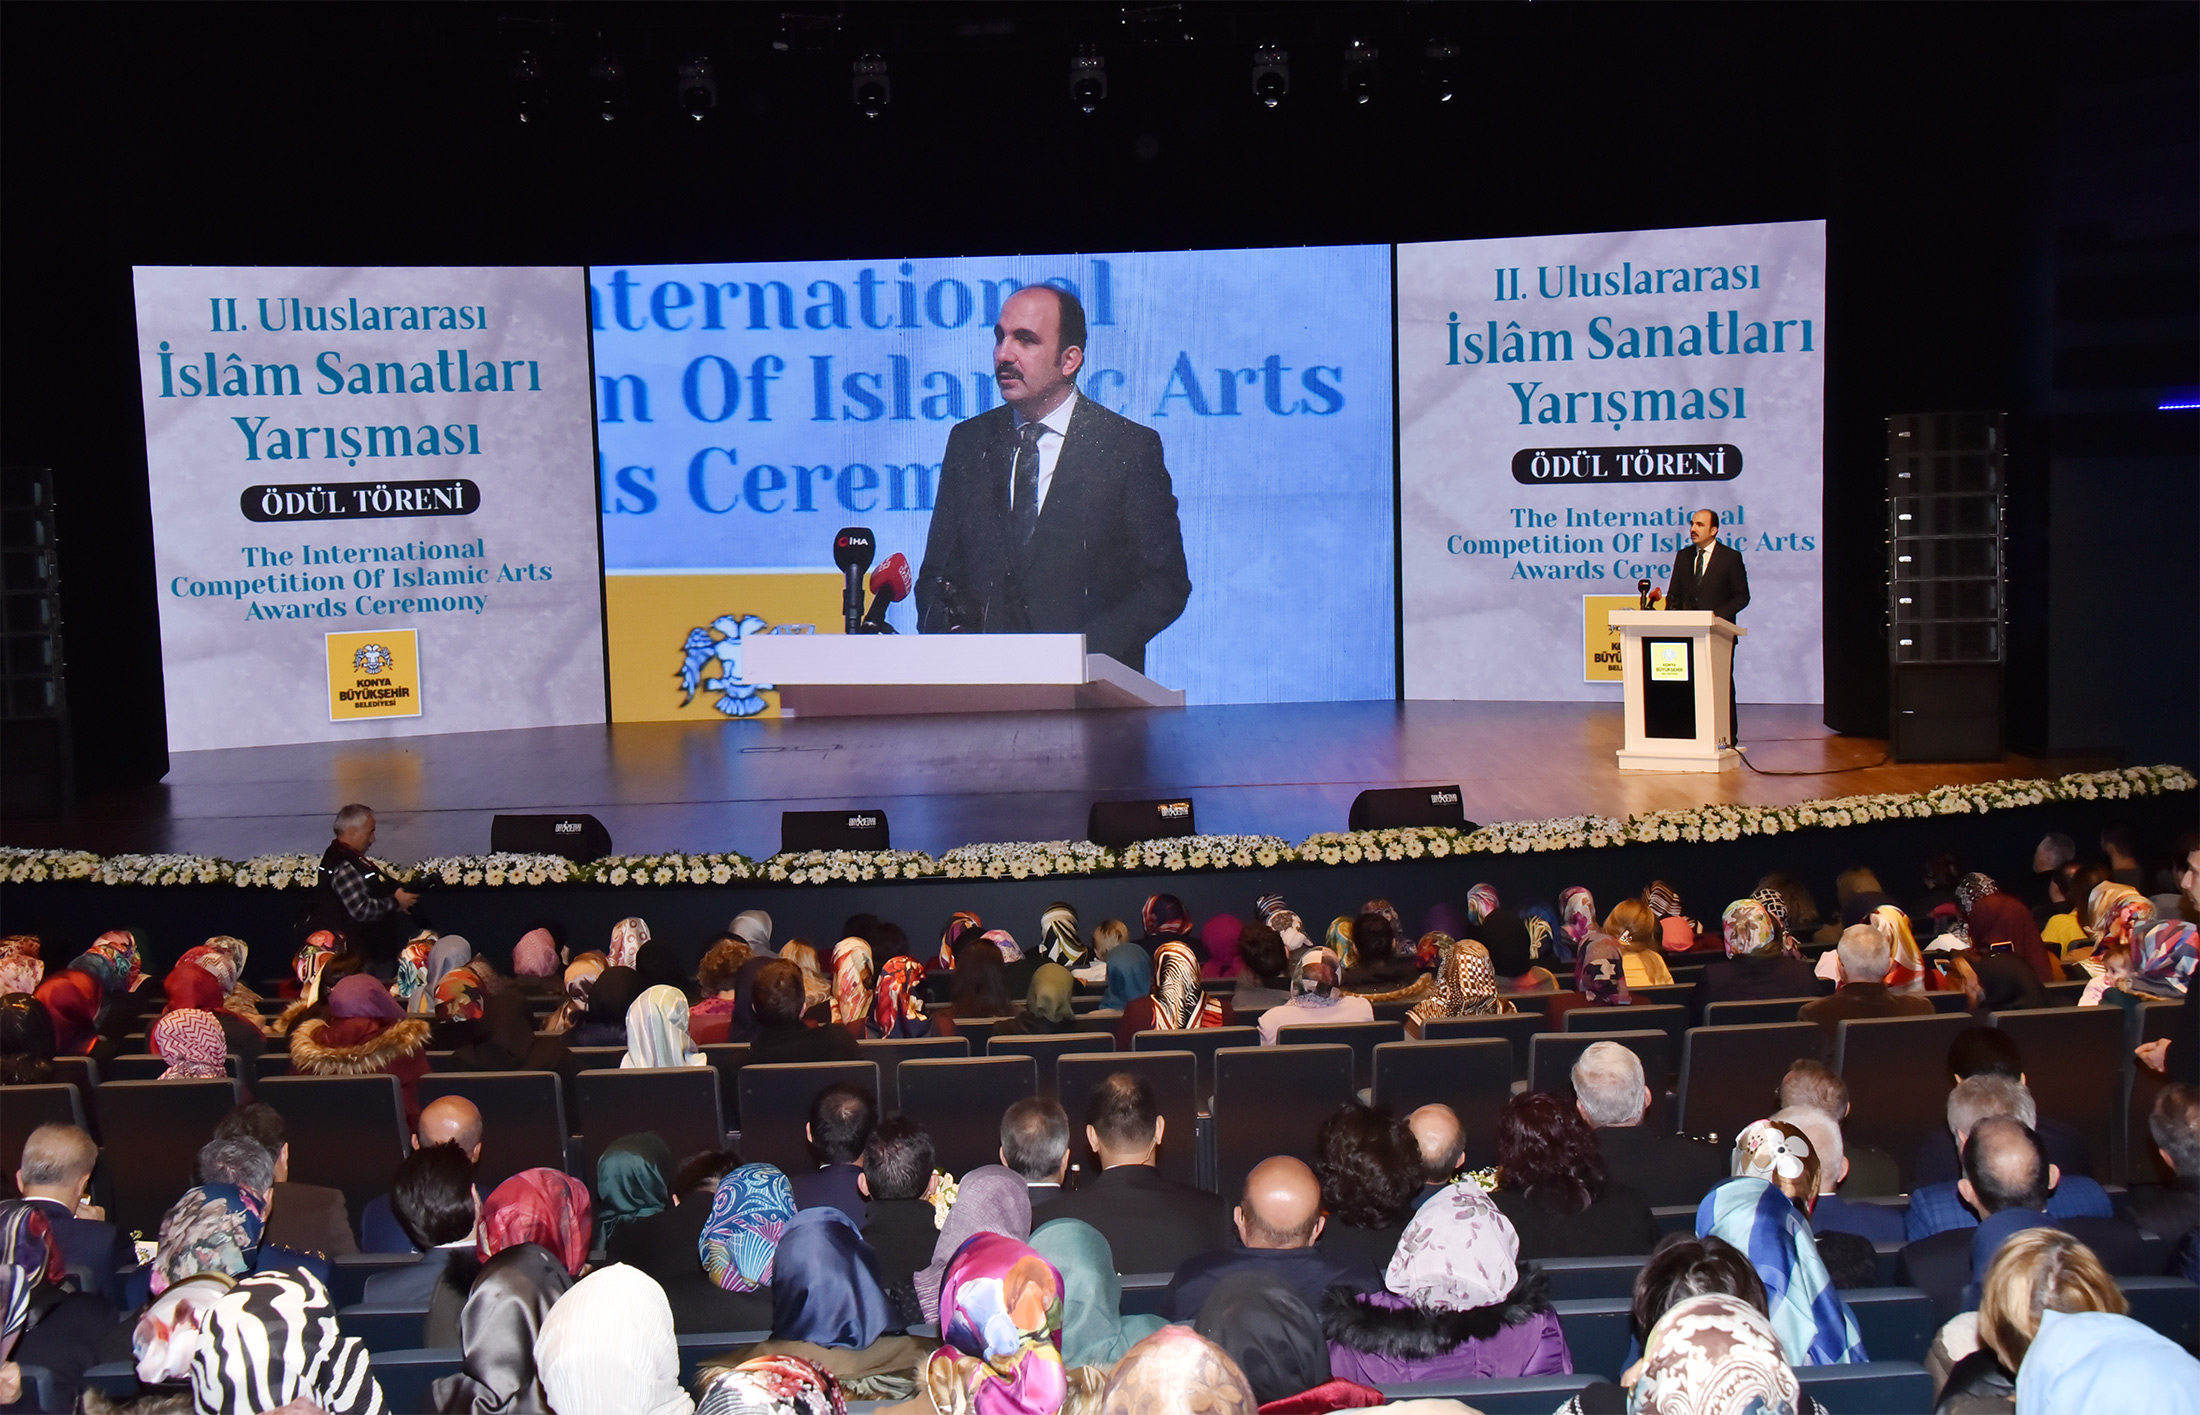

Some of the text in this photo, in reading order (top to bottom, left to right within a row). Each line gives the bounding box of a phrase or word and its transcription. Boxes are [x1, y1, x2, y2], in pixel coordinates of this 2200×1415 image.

[1495, 262, 1760, 301] II. Uluslararası
[210, 298, 487, 332] II. Uluslararası
[1446, 310, 1814, 365] İslâm Sanatları
[157, 341, 541, 397] İslâm Sanatları
[682, 355, 786, 423] Of
[1153, 350, 1346, 418] Arts
[1508, 382, 1746, 431] Yarışması
[231, 417, 481, 467] Yarışması
[1531, 447, 1725, 478] ÖDÜL TÖRENİ
[262, 482, 463, 515] ÖDÜL TÖRENİ
[1511, 509, 1557, 527] The
[242, 538, 484, 567] The International
[1448, 534, 1603, 558] Competition
[1613, 533, 1643, 553] Of
[1756, 532, 1815, 551] Arts
[171, 564, 552, 599] Competition Of Islamic Arts
[1511, 560, 1605, 579] Awards
[246, 595, 487, 620] Awards Ceremony
[339, 686, 409, 701] BÜYÜKŞEHİR
[357, 678, 392, 687] KONYA
[355, 700, 396, 708] BELEDİYESİ
